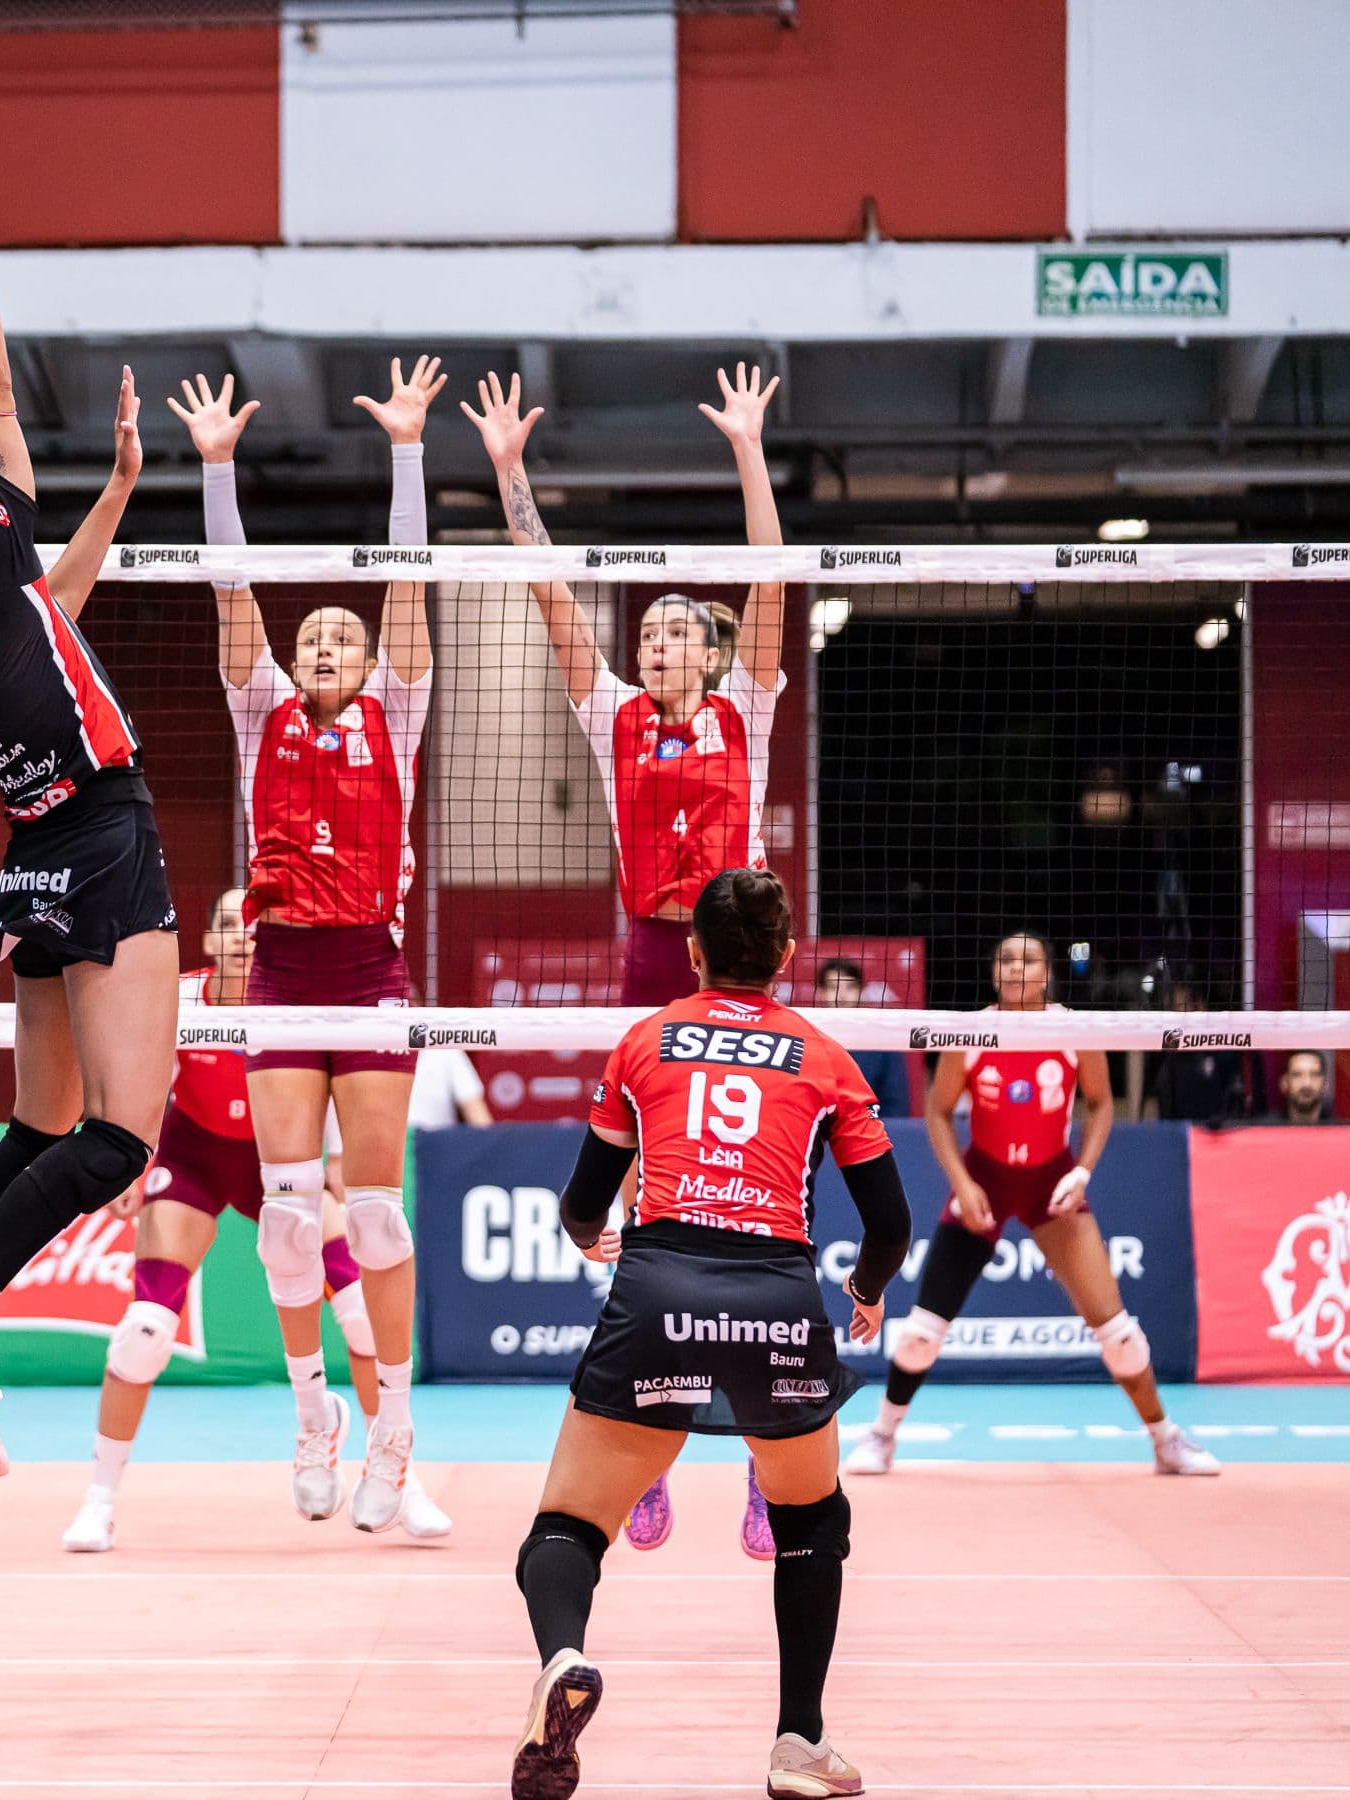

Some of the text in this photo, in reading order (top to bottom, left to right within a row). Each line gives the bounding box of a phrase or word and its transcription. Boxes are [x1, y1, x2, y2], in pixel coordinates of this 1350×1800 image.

[1044, 254, 1220, 296] SAÍDA
[138, 549, 199, 566] SUPERLIGA
[370, 549, 432, 566] SUPERLIGA
[604, 549, 666, 566] SUPERLIGA
[838, 549, 901, 567] SUPERLIGA
[1074, 549, 1137, 566] SUPERLIGA
[1311, 548, 1350, 564] SUPER
[707, 1009, 763, 1023] PENALTY
[180, 1028, 247, 1045] SUPERLIGA
[429, 1030, 497, 1046] SUPERLIGA
[930, 1033, 998, 1049] SUPERLIGA
[1183, 1033, 1251, 1048] SUPERLIGA
[671, 1024, 792, 1070] SESI
[686, 1071, 762, 1145] 19
[699, 1145, 744, 1169] LÉIA
[664, 1312, 810, 1346] Unimed
[770, 1352, 805, 1368] Bauru
[634, 1375, 712, 1393] PACAEMBU
